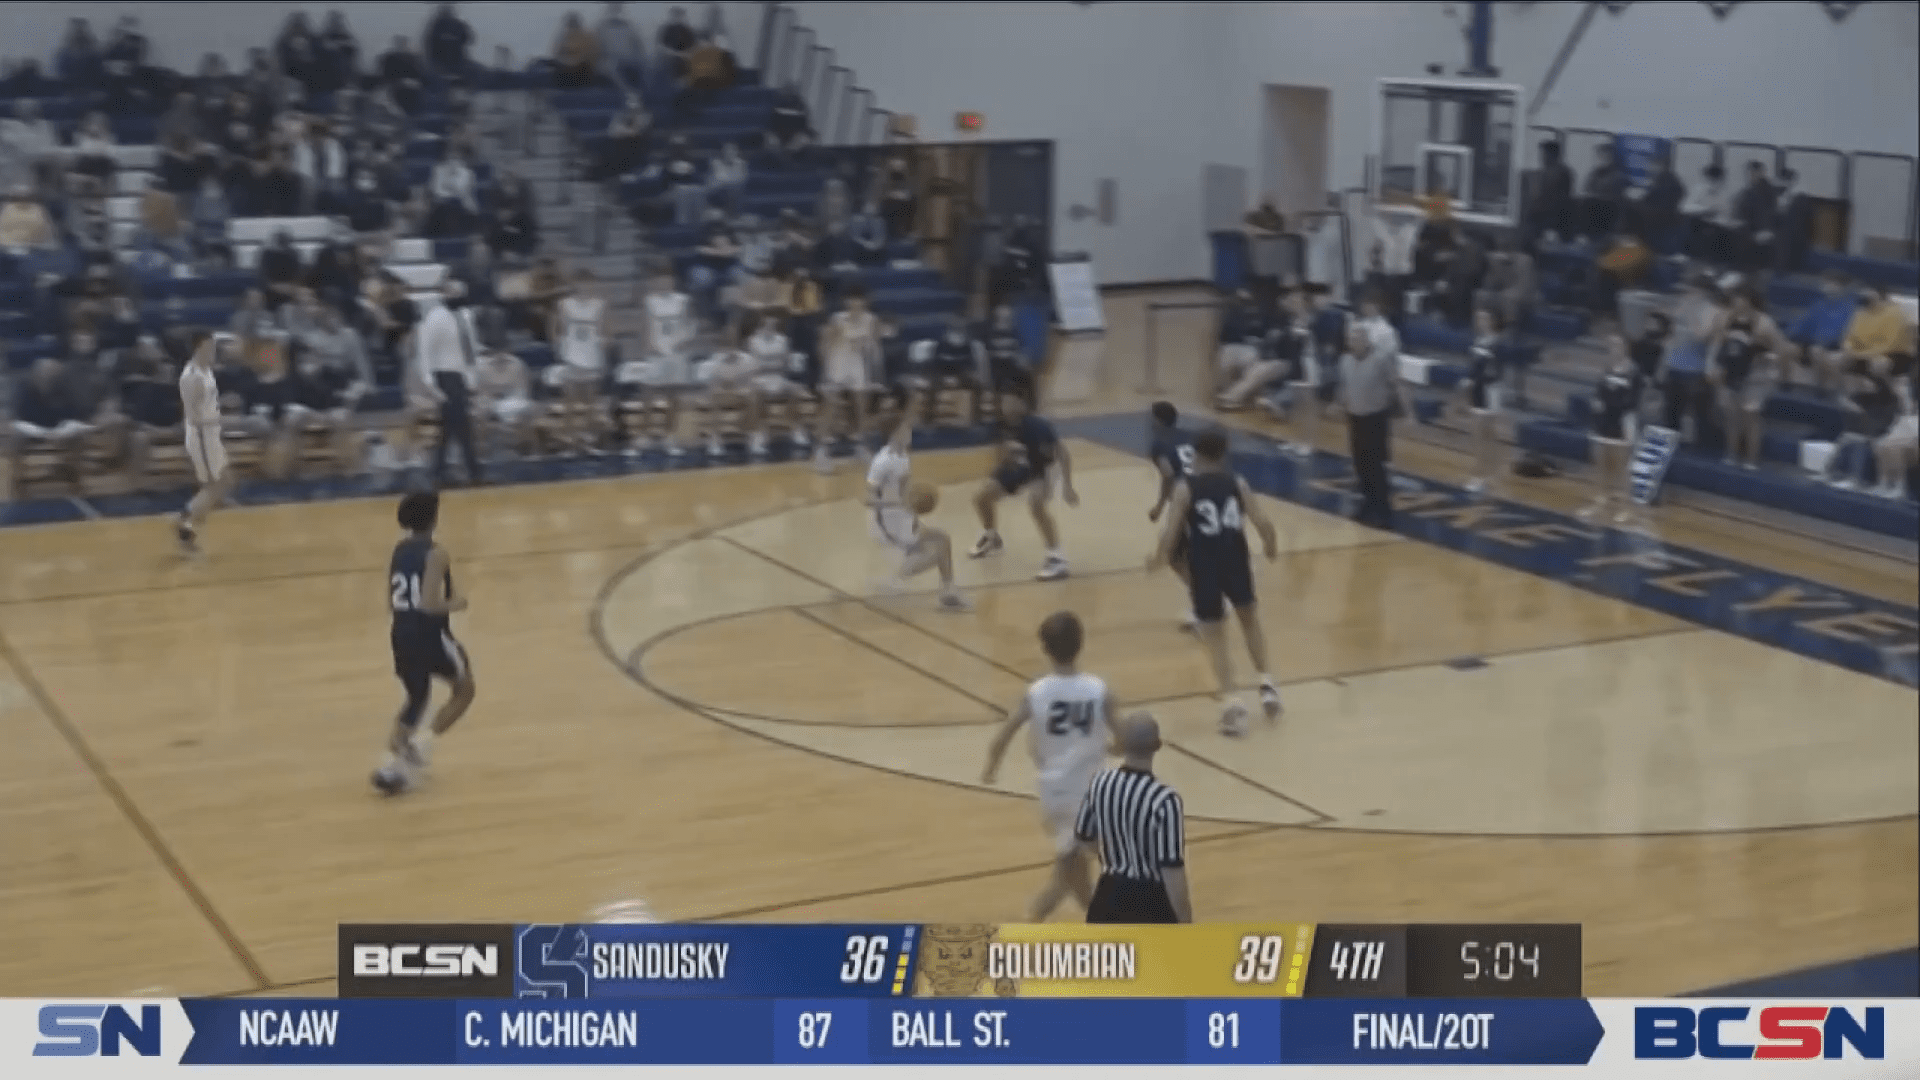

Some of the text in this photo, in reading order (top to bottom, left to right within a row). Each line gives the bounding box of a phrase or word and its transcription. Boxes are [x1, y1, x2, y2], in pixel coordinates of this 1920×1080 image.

[1195, 495, 1241, 536] 34
[391, 572, 420, 610] 21
[1047, 700, 1094, 736] 24
